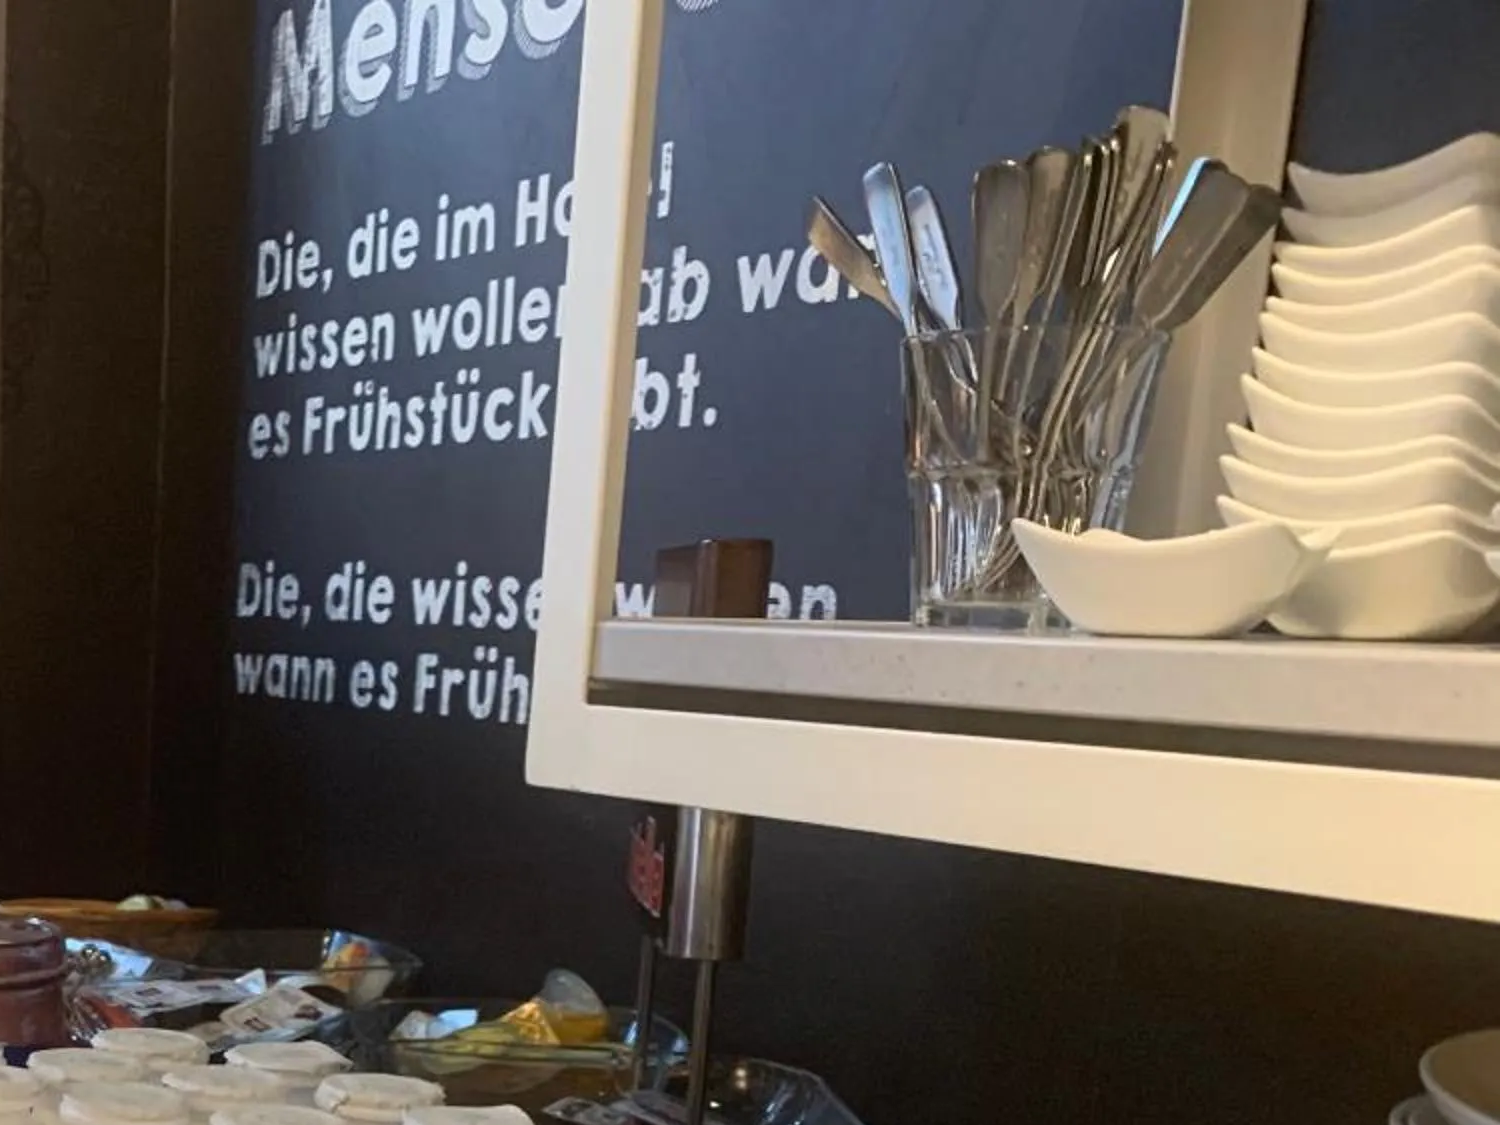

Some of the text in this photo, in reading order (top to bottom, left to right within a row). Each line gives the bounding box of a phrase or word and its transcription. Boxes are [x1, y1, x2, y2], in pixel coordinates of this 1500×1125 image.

[256, 230, 333, 298] Die,
[347, 208, 420, 279] die
[435, 194, 495, 261] im
[253, 313, 395, 379] wissen
[248, 411, 291, 460] es
[302, 367, 551, 455] Frühstück
[236, 560, 311, 628] Die,
[324, 560, 396, 625] die
[412, 560, 544, 631] wisse
[233, 645, 530, 725] wann es Früh
